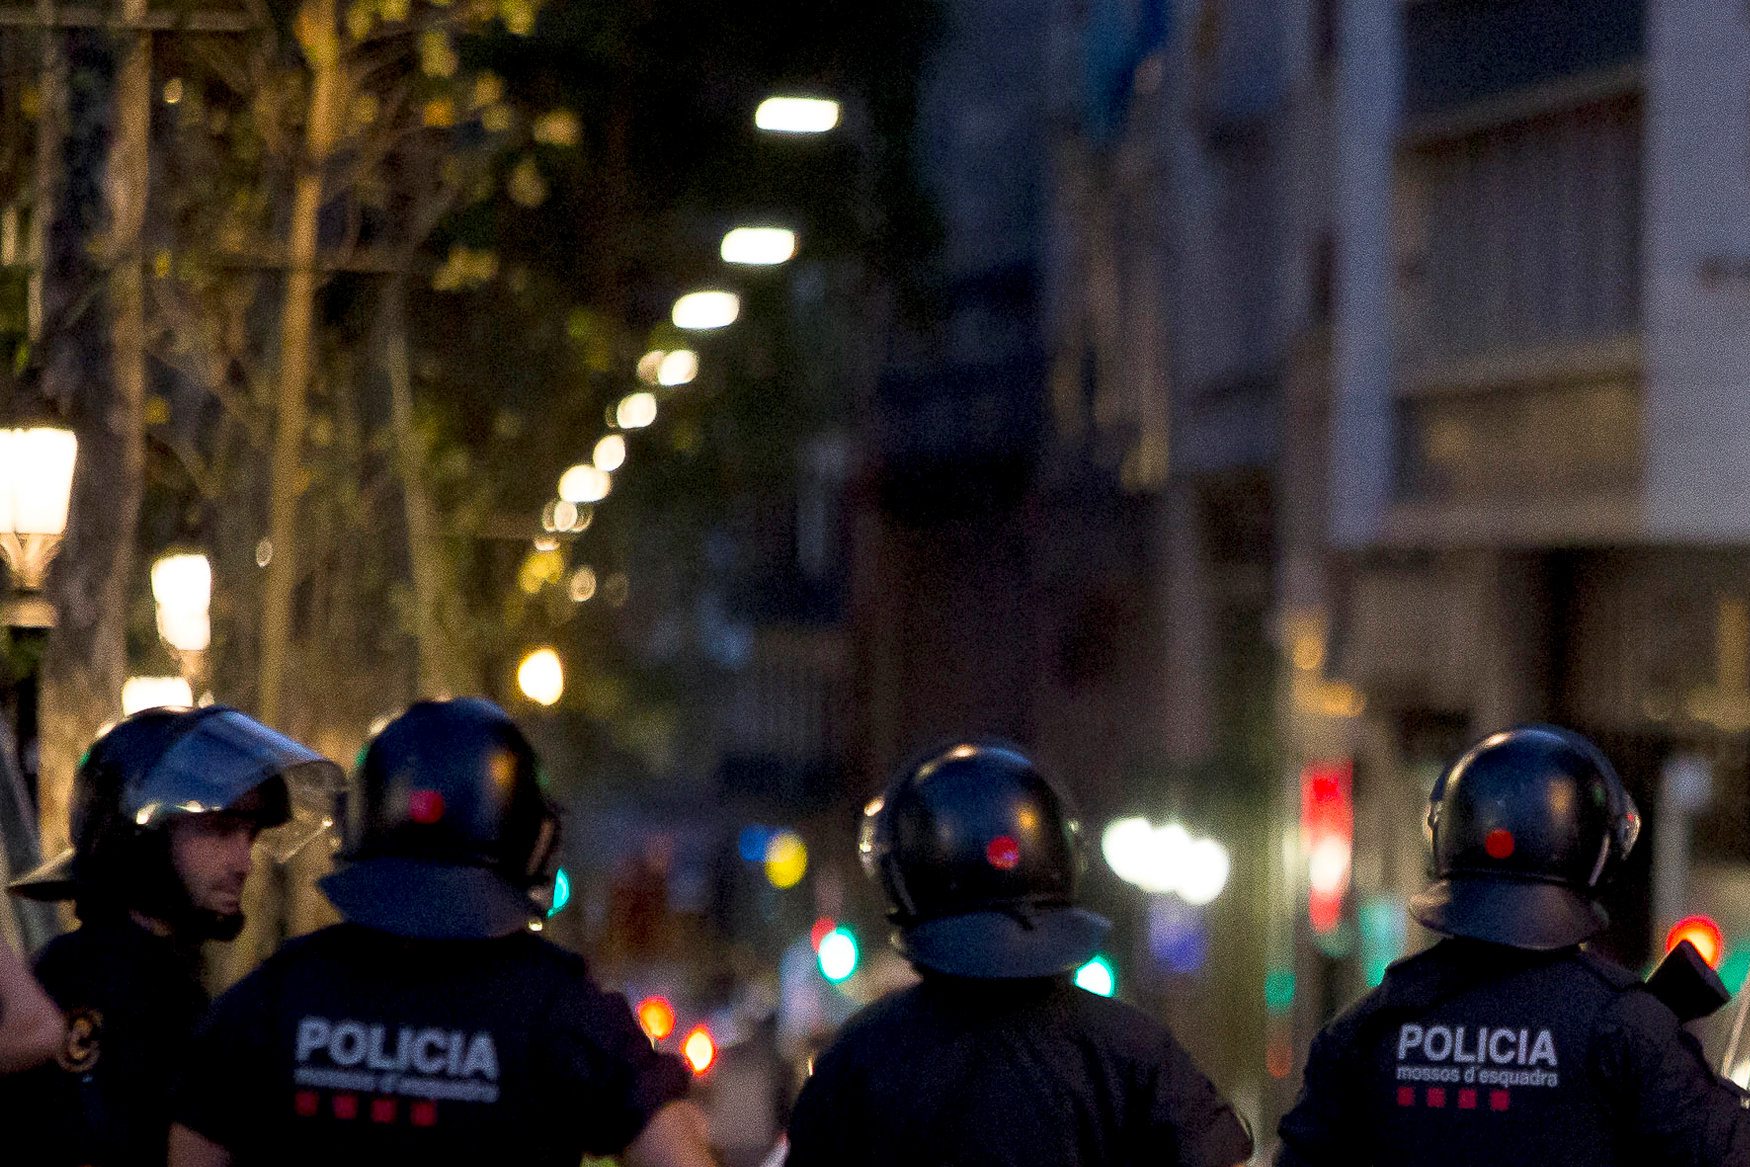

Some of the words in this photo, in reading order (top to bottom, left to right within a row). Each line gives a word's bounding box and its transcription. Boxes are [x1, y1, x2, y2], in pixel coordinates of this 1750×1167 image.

[296, 1016, 499, 1080] POLICIA
[1397, 1023, 1558, 1066] POLICIA
[1397, 1065, 1460, 1083] mossos
[1464, 1065, 1559, 1088] d'esquadra
